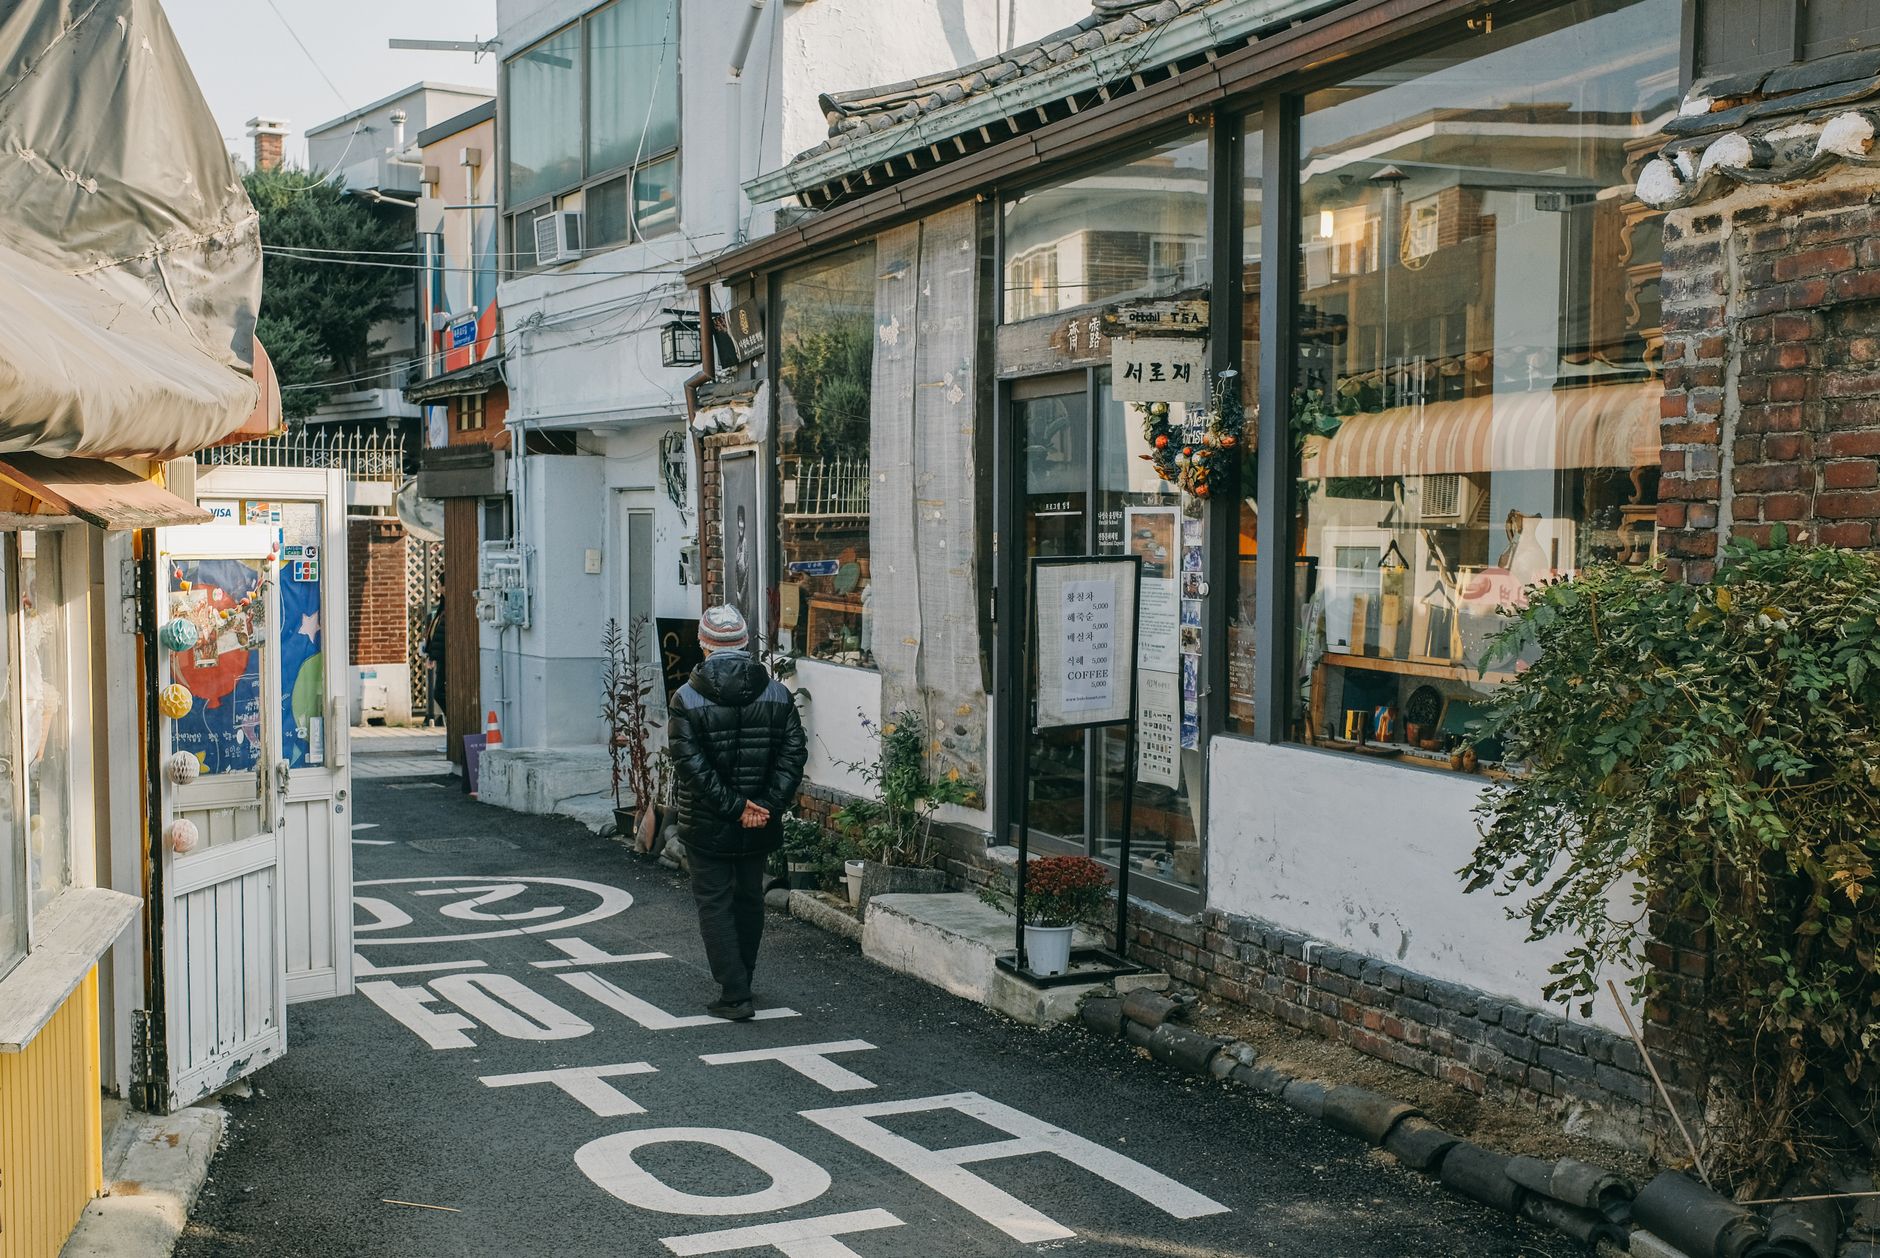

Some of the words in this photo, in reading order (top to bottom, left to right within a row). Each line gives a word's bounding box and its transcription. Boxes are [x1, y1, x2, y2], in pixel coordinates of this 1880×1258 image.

[1170, 312, 1199, 324] TEA
[1123, 361, 1191, 383] 서로재
[210, 508, 232, 517] VISA
[295, 566, 316, 575] JCB
[1092, 602, 1109, 611] 5,000
[1092, 622, 1109, 631] 5,000
[1091, 642, 1108, 651] 5,000
[1091, 656, 1108, 665] 5,000
[1067, 669, 1109, 681] COFFEE
[1091, 680, 1107, 689] 5,000
